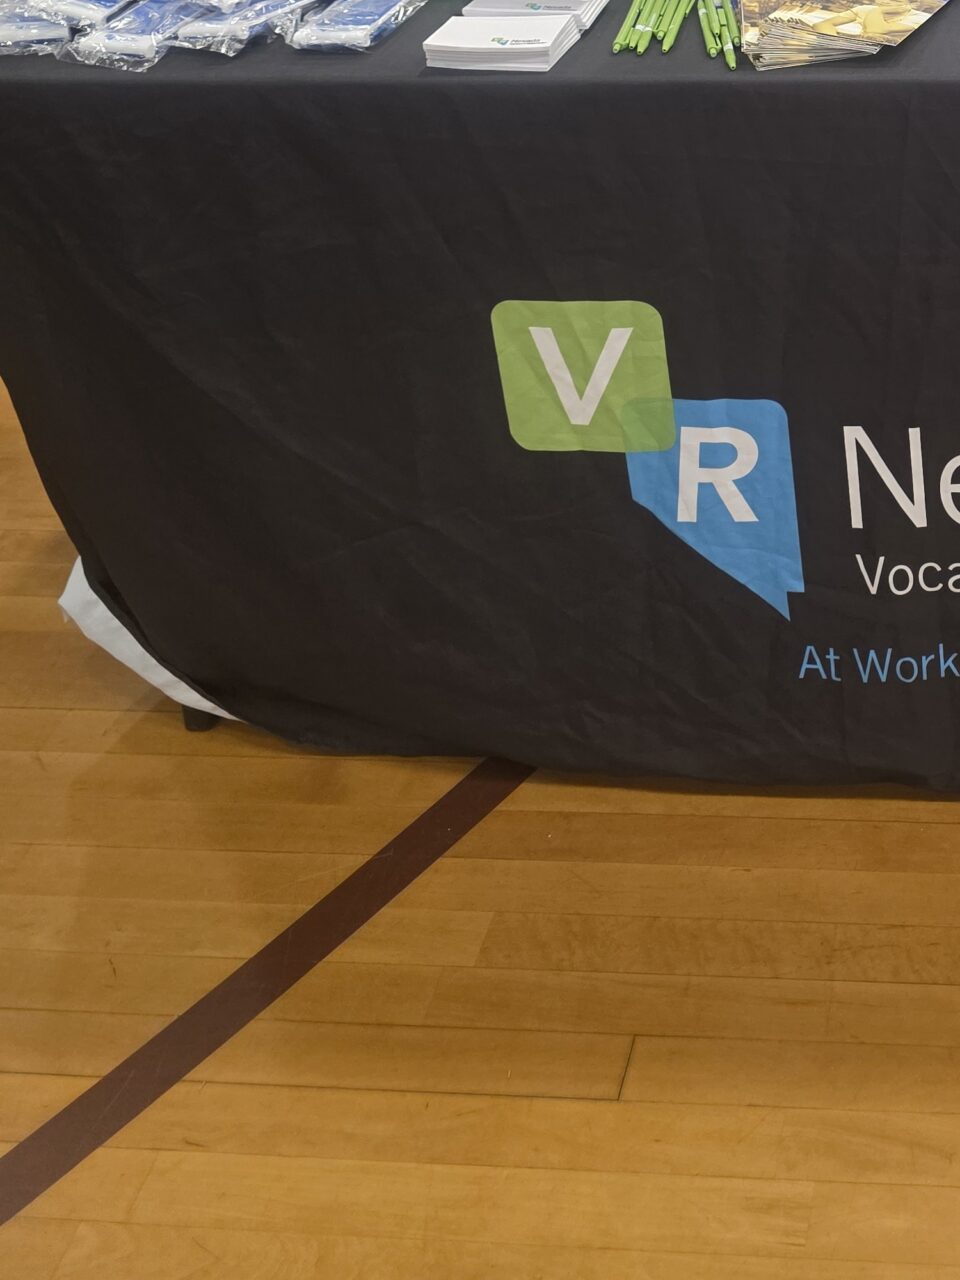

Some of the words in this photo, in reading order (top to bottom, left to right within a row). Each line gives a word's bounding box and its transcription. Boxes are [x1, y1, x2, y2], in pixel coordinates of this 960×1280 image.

[528, 326, 634, 426] V
[676, 426, 759, 523] R
[799, 645, 841, 681] At
[851, 644, 960, 683] Work
